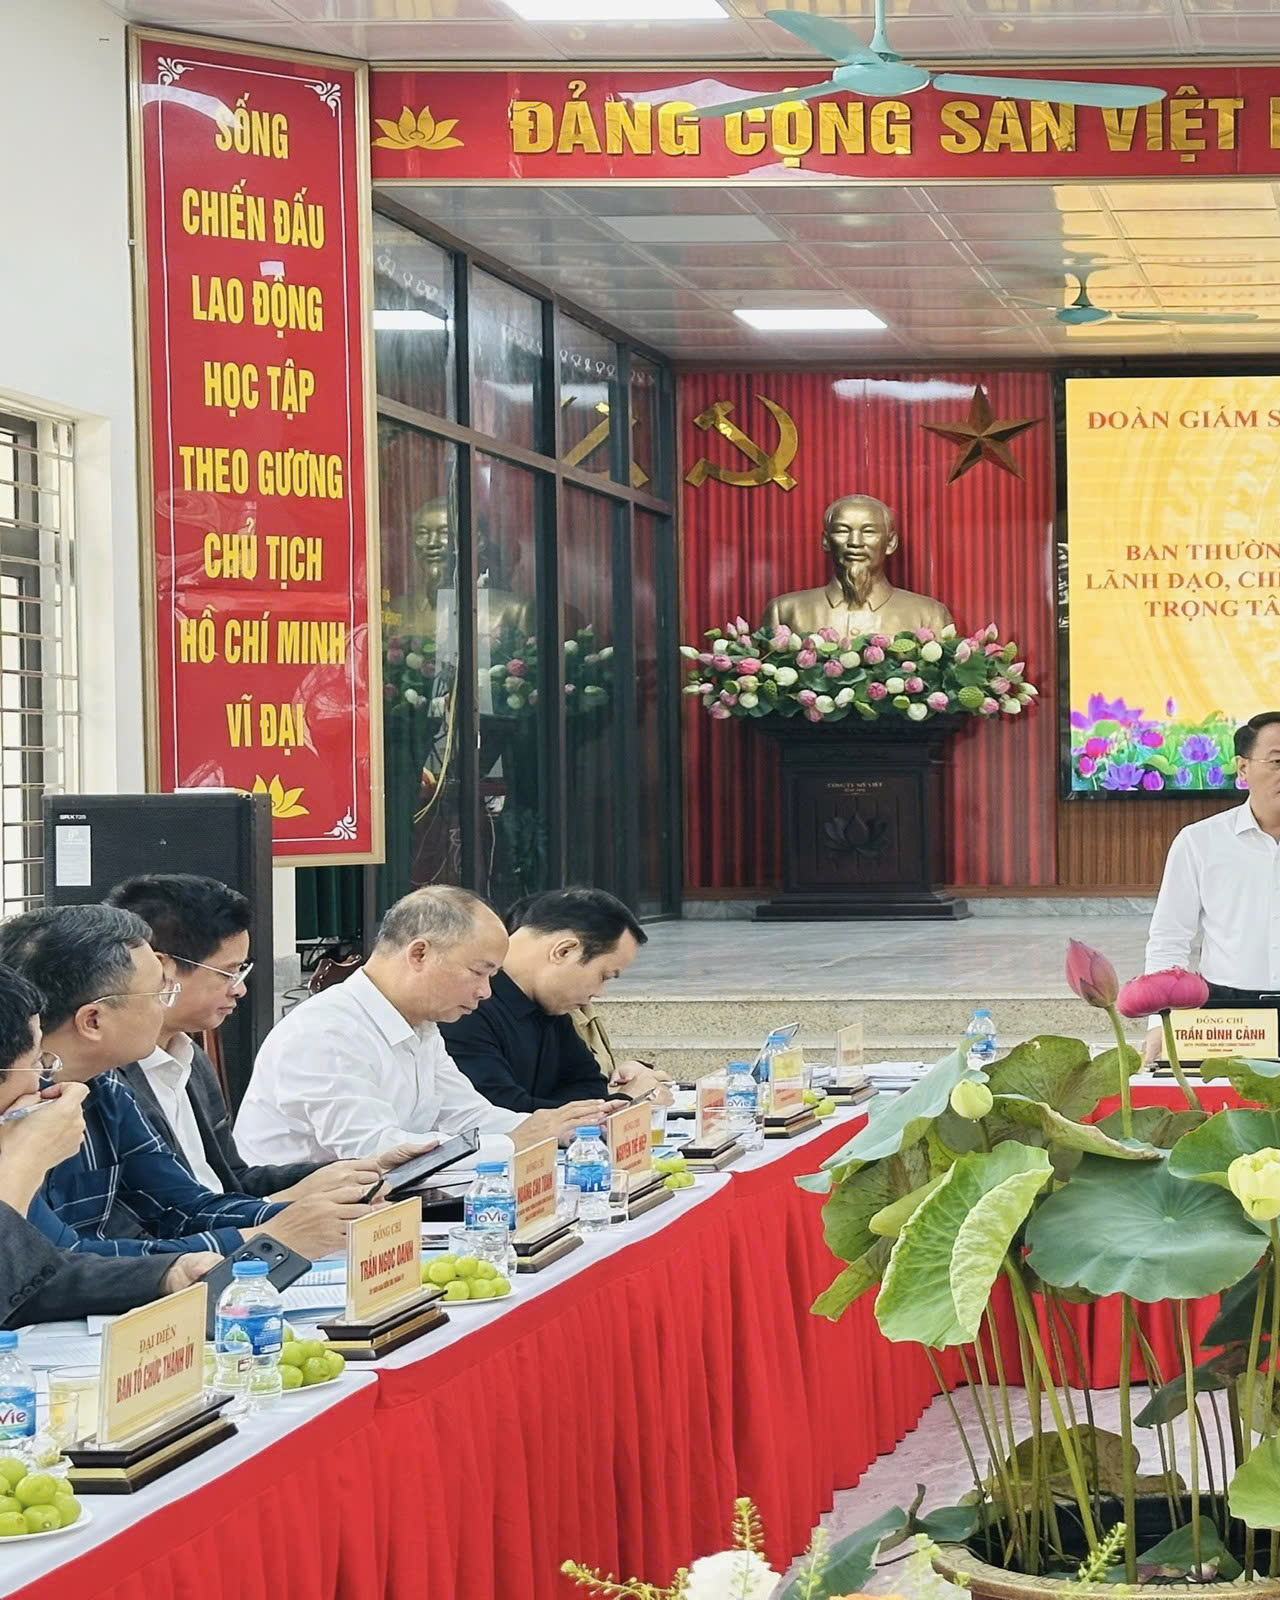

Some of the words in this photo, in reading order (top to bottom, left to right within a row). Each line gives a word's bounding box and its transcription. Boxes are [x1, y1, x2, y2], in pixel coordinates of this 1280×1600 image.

[215, 92, 289, 160] SỐNG
[509, 79, 702, 156] ĐẢNG
[723, 87, 912, 168] CỘNG
[1100, 85, 1245, 164] VIỆT
[181, 178, 265, 243] CHIẾN
[273, 187, 325, 250] ĐẤU
[190, 274, 244, 324] LAO
[252, 275, 324, 338] ĐỘNG
[203, 361, 258, 418] HỌC
[266, 358, 315, 420] TẬP
[1088, 406, 1168, 430] ĐOÀN
[1179, 404, 1257, 429] GIÁM
[179, 445, 249, 495] THEO
[257, 448, 344, 499] GƯƠNG
[203, 517, 257, 580] CHỦ
[265, 535, 323, 590] TỊCH
[1086, 570, 1158, 591] LÃNH
[1167, 573, 1232, 593] ĐẠO,
[1126, 543, 1178, 562] BAN
[179, 602, 216, 664] HỒ
[224, 611, 270, 665] CHÍ
[276, 620, 346, 665] MINH
[1144, 600, 1239, 622] TRỌNG
[225, 693, 253, 748] VĨ
[259, 702, 304, 756] ĐẠI
[1206, 1026, 1233, 1040] ĐÌNH
[1235, 1025, 1265, 1040] CẢNH
[139, 1335, 155, 1355] ĐẠI
[156, 1324, 177, 1346] DIỆN
[116, 1372, 132, 1403] BAN
